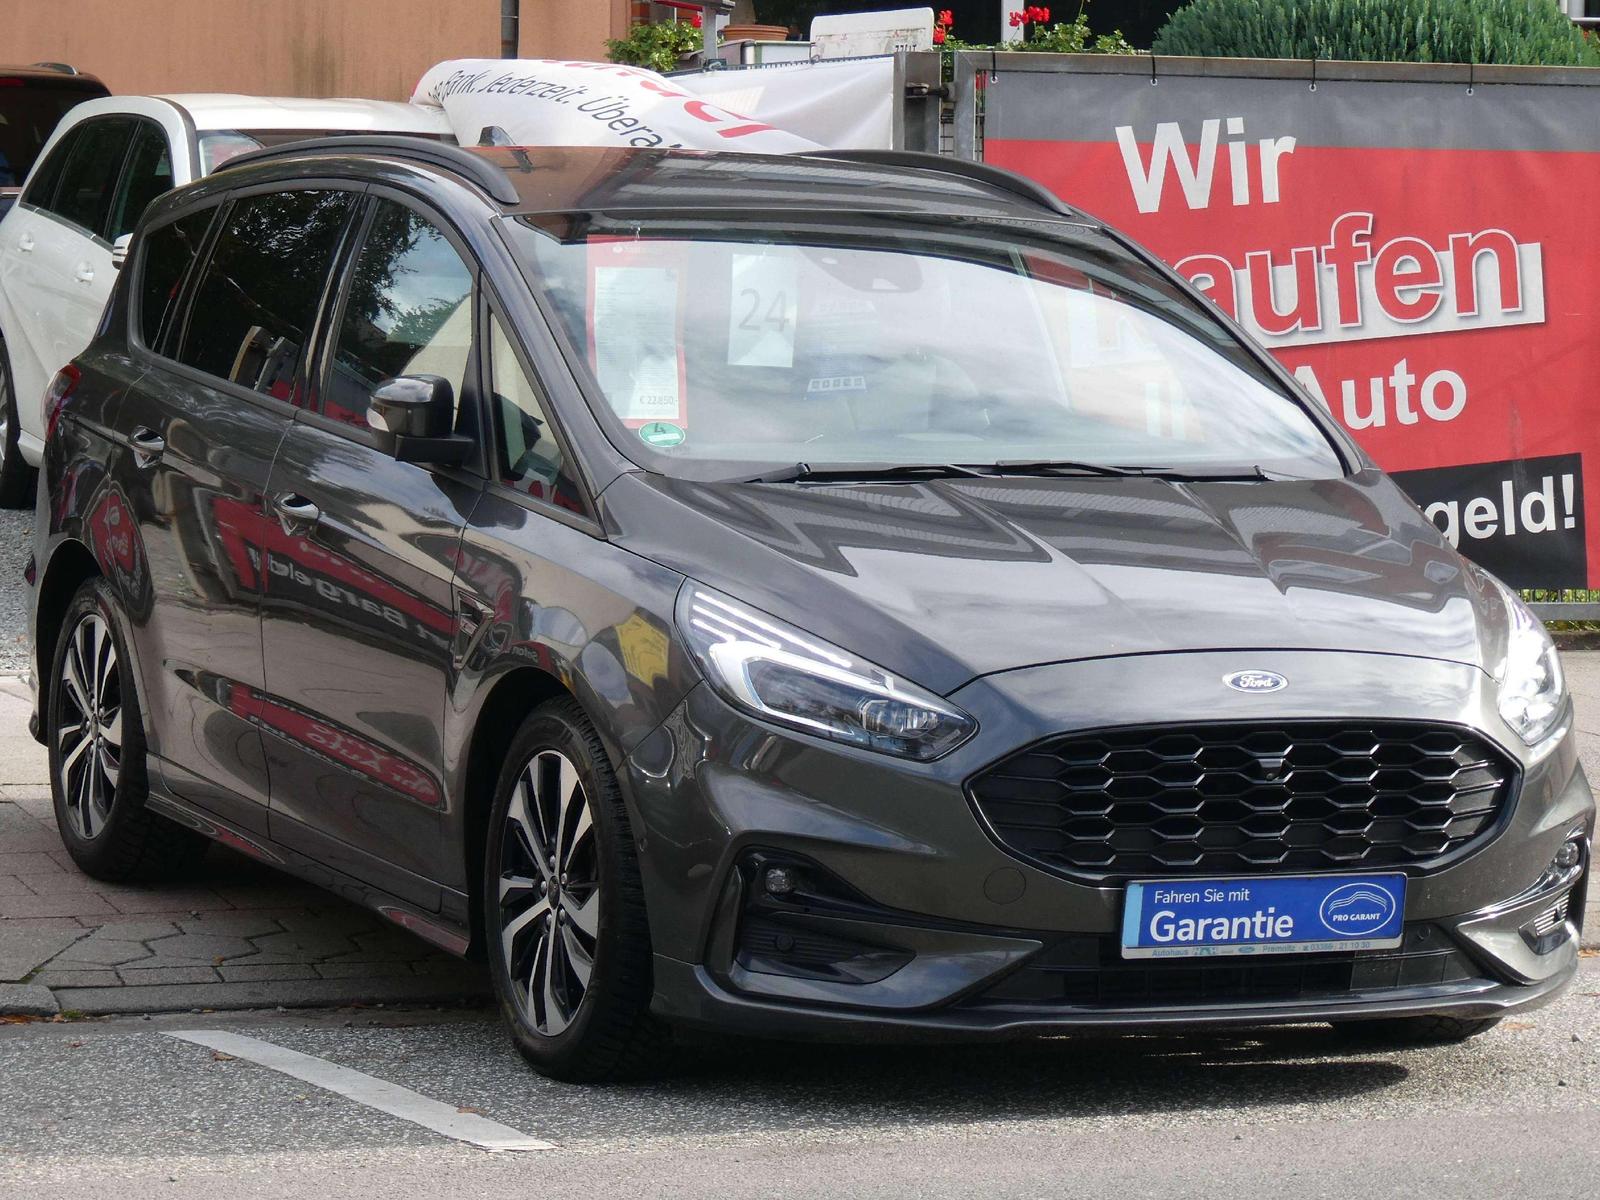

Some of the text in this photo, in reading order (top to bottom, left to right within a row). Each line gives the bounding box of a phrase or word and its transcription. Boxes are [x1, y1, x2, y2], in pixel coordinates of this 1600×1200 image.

[477, 72, 587, 104] Jederzeit.
[577, 95, 683, 147] Übera
[1115, 117, 1297, 213] Wir
[1173, 211, 1523, 336] aufen
[738, 288, 790, 332] 24
[1418, 474, 1576, 550] geld!
[1149, 907, 1294, 941] Garantie
[1154, 887, 1250, 904] Fahren Sie mit
[1332, 913, 1381, 922] PRO GARANT
